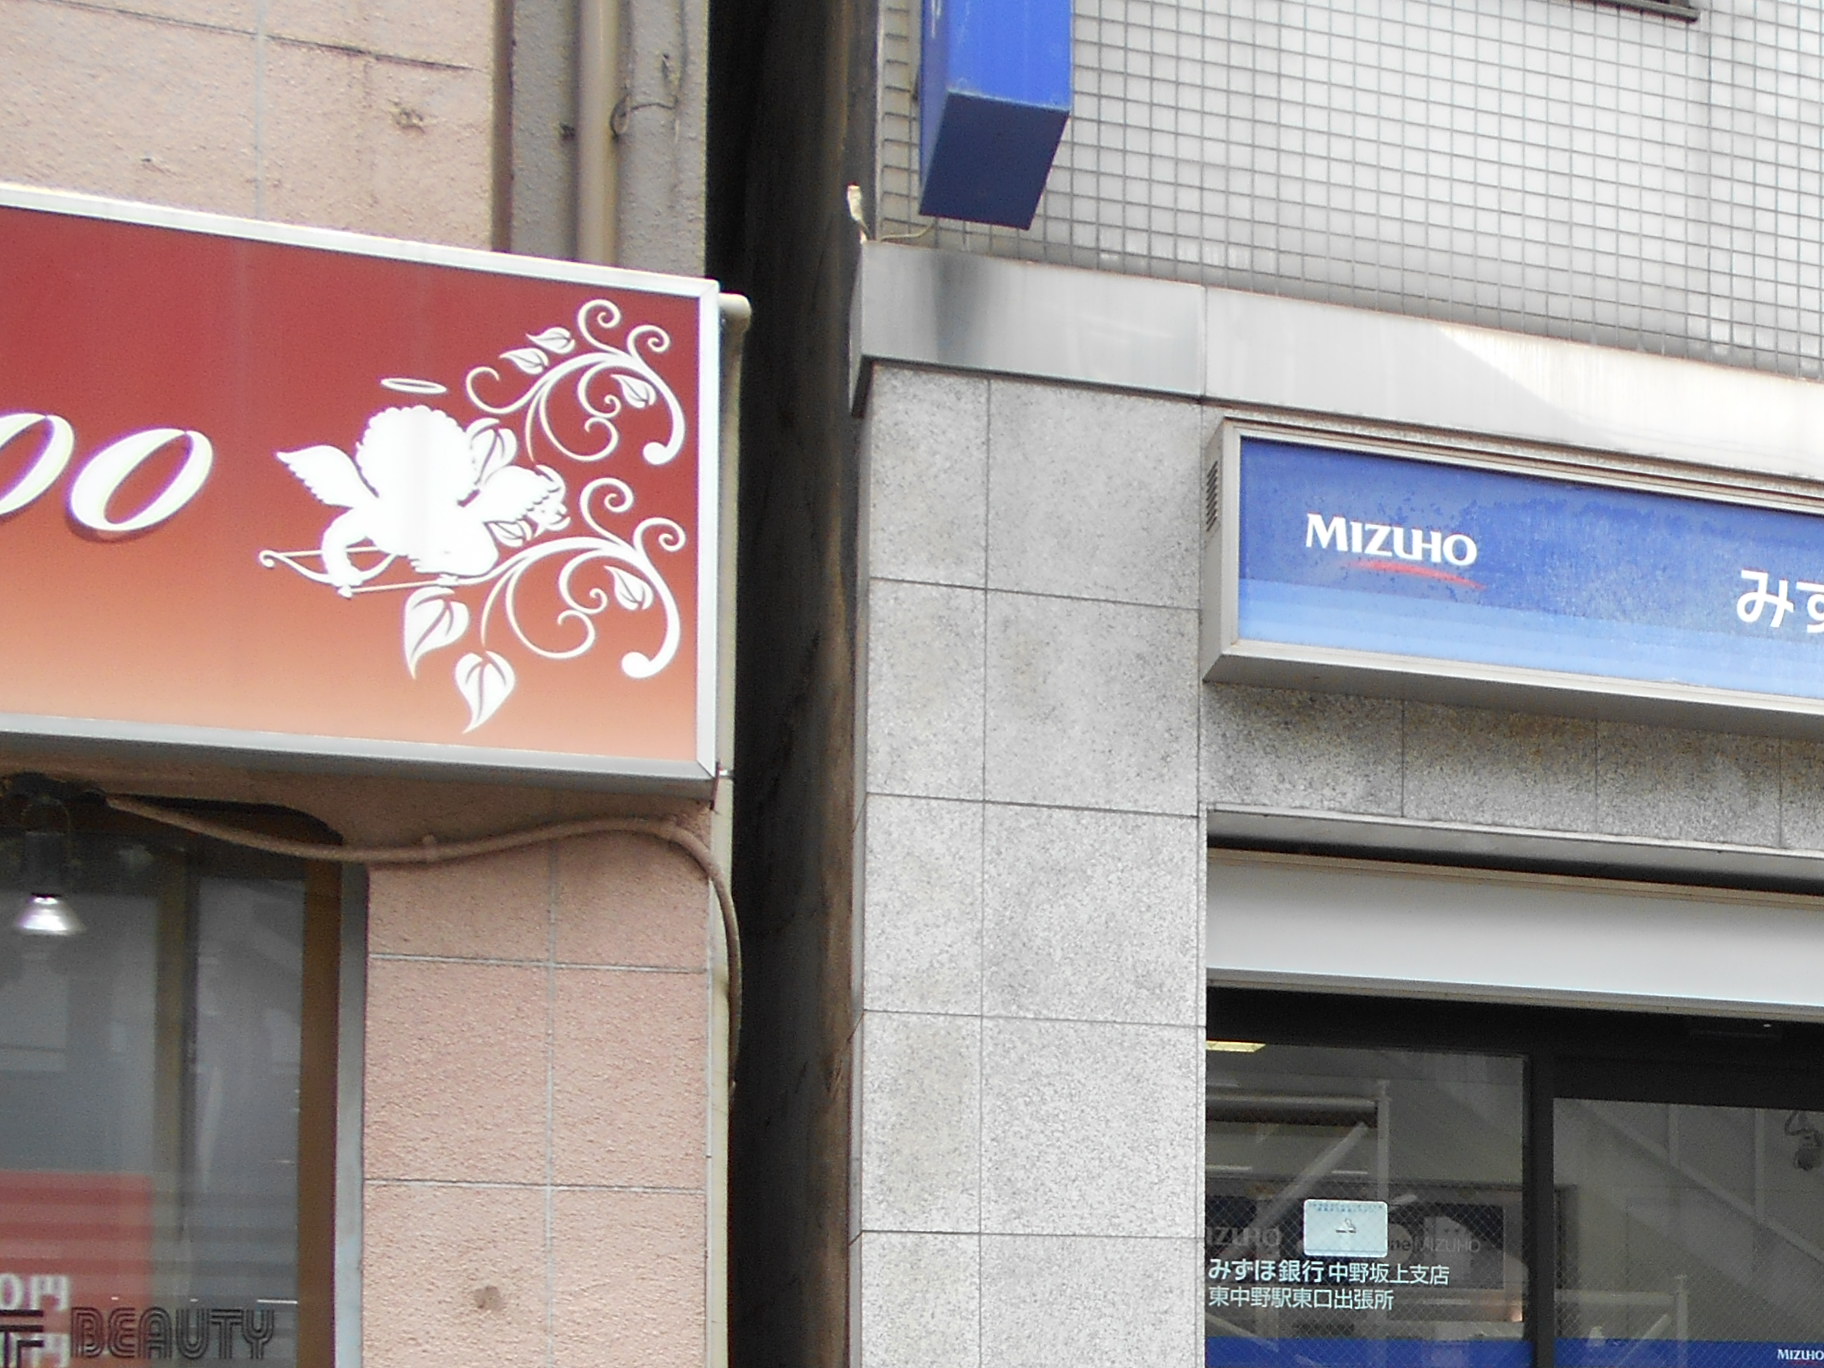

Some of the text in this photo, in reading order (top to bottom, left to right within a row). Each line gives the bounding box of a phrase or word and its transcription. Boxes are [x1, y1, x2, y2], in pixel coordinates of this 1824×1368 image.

[1305, 512, 1478, 567] MIZUHO
[1203, 1225, 1282, 1248] IZUHO
[1207, 1286, 1395, 1311] 東中野駅東口出張所
[70, 1306, 276, 1361] BEAUTY
